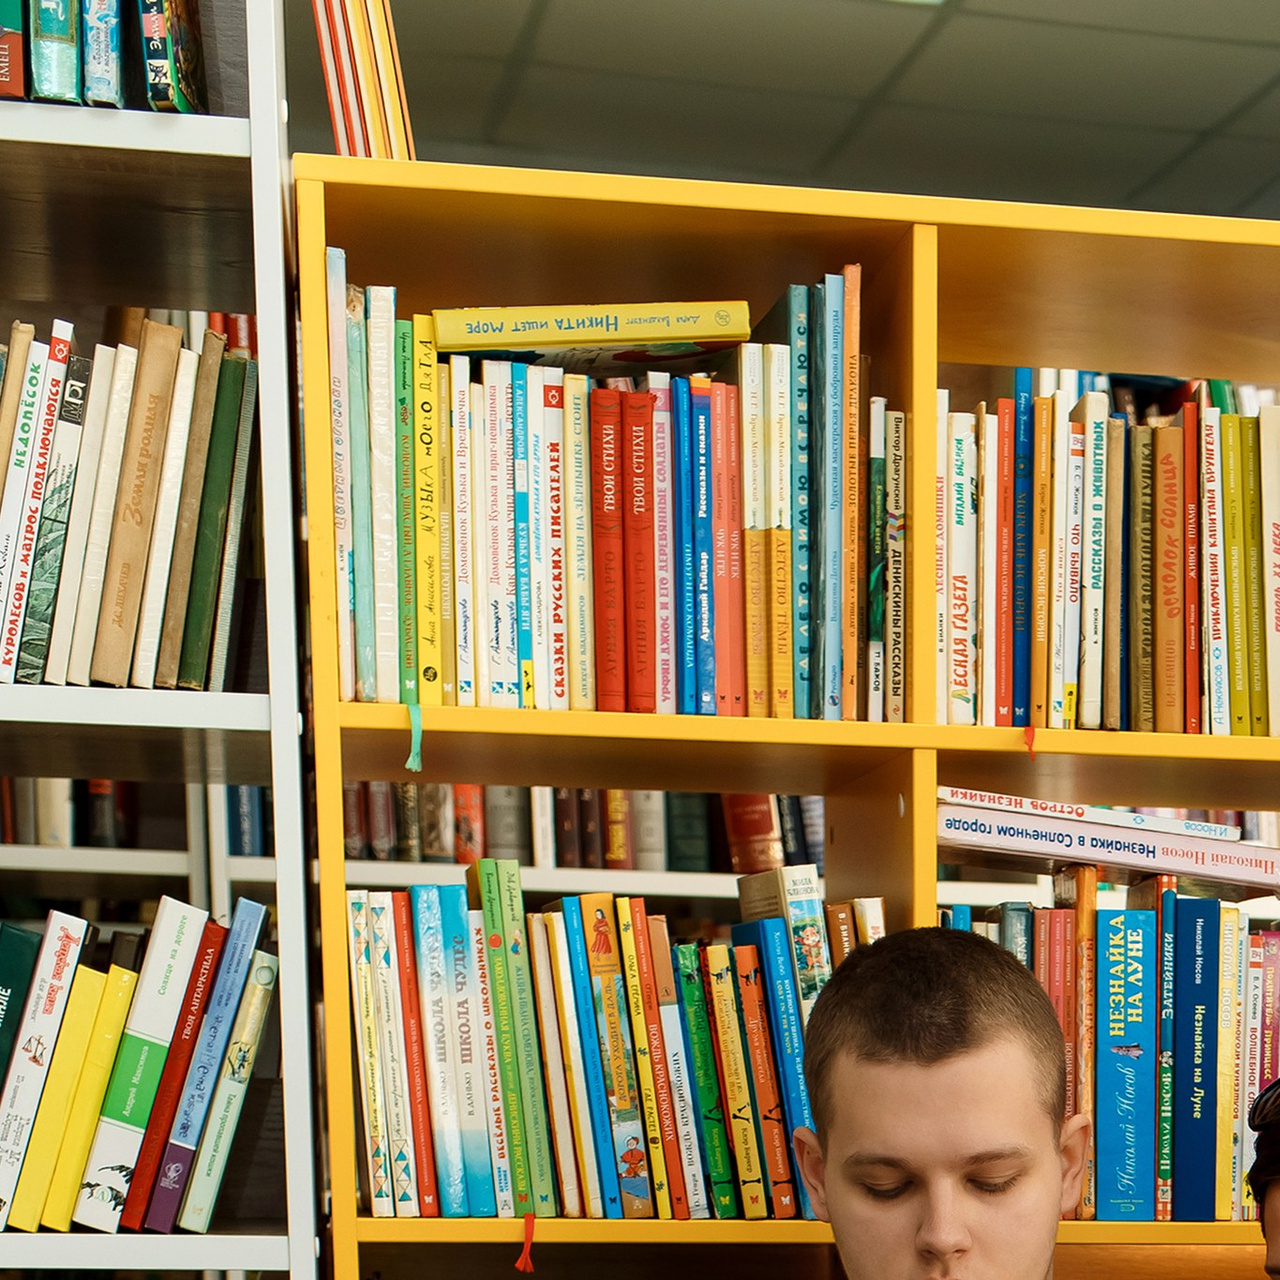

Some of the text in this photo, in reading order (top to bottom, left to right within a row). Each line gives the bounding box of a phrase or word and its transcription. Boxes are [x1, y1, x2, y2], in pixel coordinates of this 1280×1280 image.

[13, 362, 41, 468] НЕДОПЁСОК
[697, 415, 706, 456] сказки
[603, 425, 615, 512] ТВОИ СТИХИ
[697, 467, 708, 518] Рассказы
[890, 417, 903, 510] Виктор Драгунский
[1092, 421, 1104, 497] ЖИВОТНЫХ
[1, 581, 26, 666] КУРОЛЕСОВ
[18, 506, 40, 566] МАТРОС
[30, 377, 62, 500] ПОДКЛЮЧАЮТСЯ
[953, 482, 965, 525] ВИТАЛИЙ
[1205, 424, 1222, 640] ПРИКЛЮЧЕНИЯ КАПИТАНА ВРУНГЕЛЯ
[547, 442, 564, 698] СКАЗКИ РУССКИХ ПИСАТЕЛЕЙ
[699, 552, 710, 641] Аркадий Гайдар
[1091, 517, 1102, 590] РАССКАЗЫ
[890, 550, 902, 697] ДЕНИСКИНЫ РАССКАЗЫ
[951, 575, 968, 631] ГАЗЕТА
[945, 817, 992, 835] городе
[950, 789, 1085, 819] ОСТРОВ НЕЗНАЙКИ
[996, 824, 1073, 847] Солнечном
[1090, 836, 1156, 858] Незнайка
[1161, 847, 1206, 863] Носов
[1210, 854, 1275, 875] Николай
[181, 948, 215, 1040] ТВОЯ АНТАРКТИДА
[453, 934, 473, 1064] ШКОЛА ЧУДЕС
[474, 927, 492, 1017] ШКОЛЬНИКАХ
[1106, 915, 1125, 1036] НЕЗНАЙКА
[1128, 928, 1143, 1022] НА ЛУНЕ
[1162, 933, 1173, 1019] ЗАТЕЙНИКИ
[122, 1045, 149, 1116] Андрей Максимов
[485, 1035, 500, 1102] РАССКАЗЫ
[1193, 1005, 1205, 1118] Незнайка на Луне
[493, 1106, 505, 1159] ВЕСЁЛЫЕ
[672, 1052, 695, 1167] ВОЖДЬ КРАСНОКОЖИХ
[1116, 1063, 1136, 1194] Николай Носов
